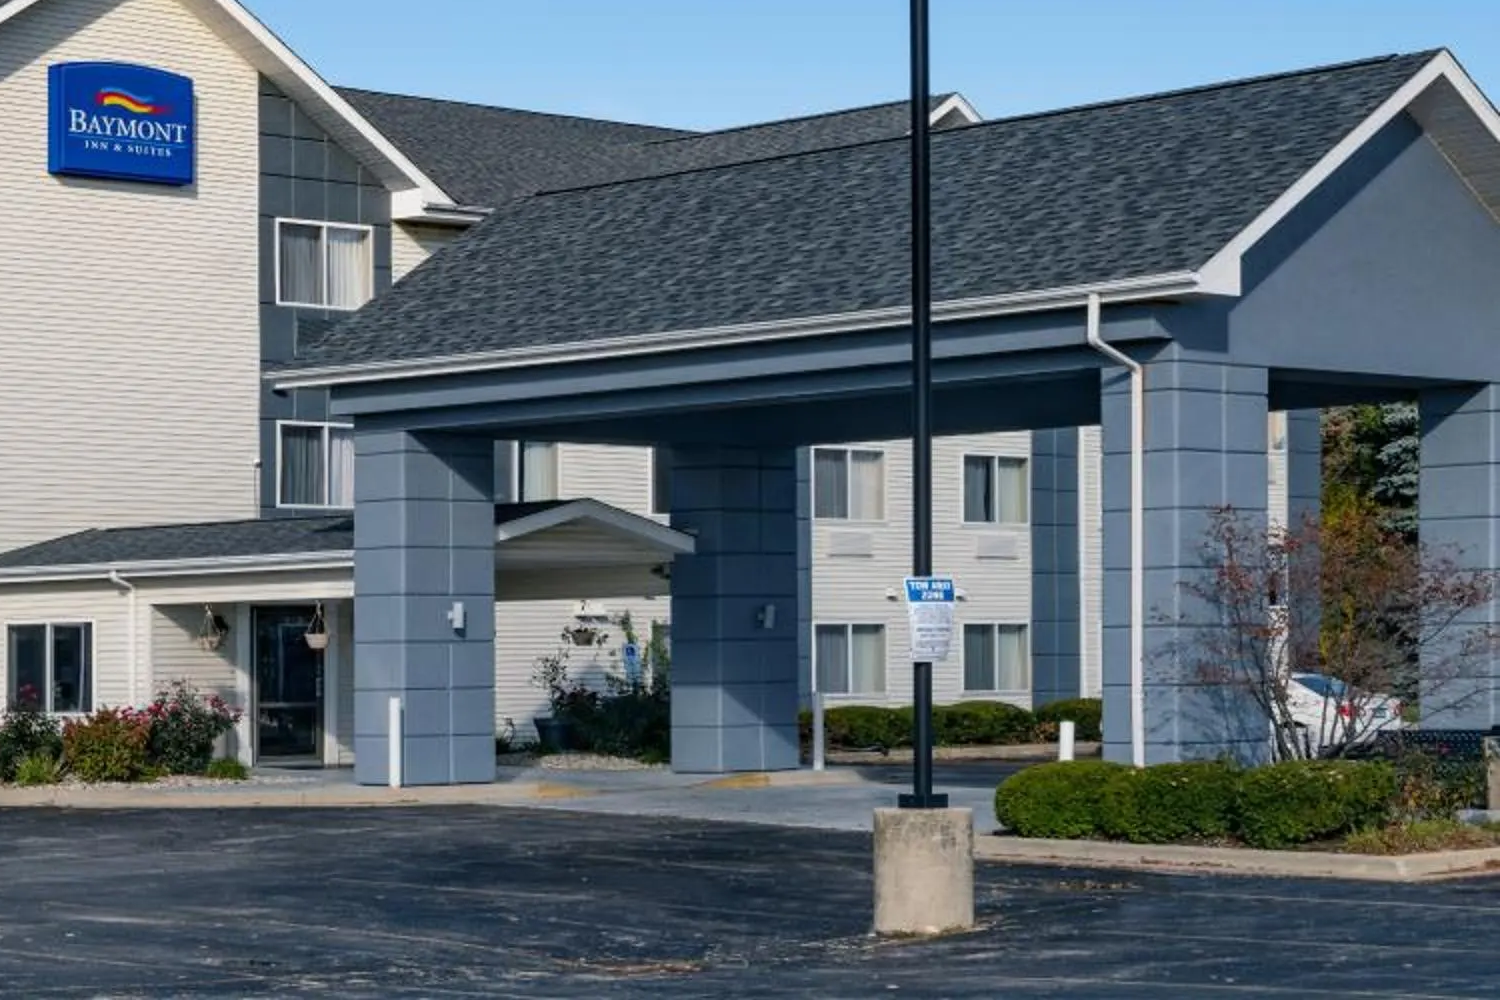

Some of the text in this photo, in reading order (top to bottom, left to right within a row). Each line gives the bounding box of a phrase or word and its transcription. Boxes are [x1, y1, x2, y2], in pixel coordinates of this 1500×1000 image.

[68, 107, 188, 144] BAYMONT
[84, 139, 173, 158] INN & SUITES
